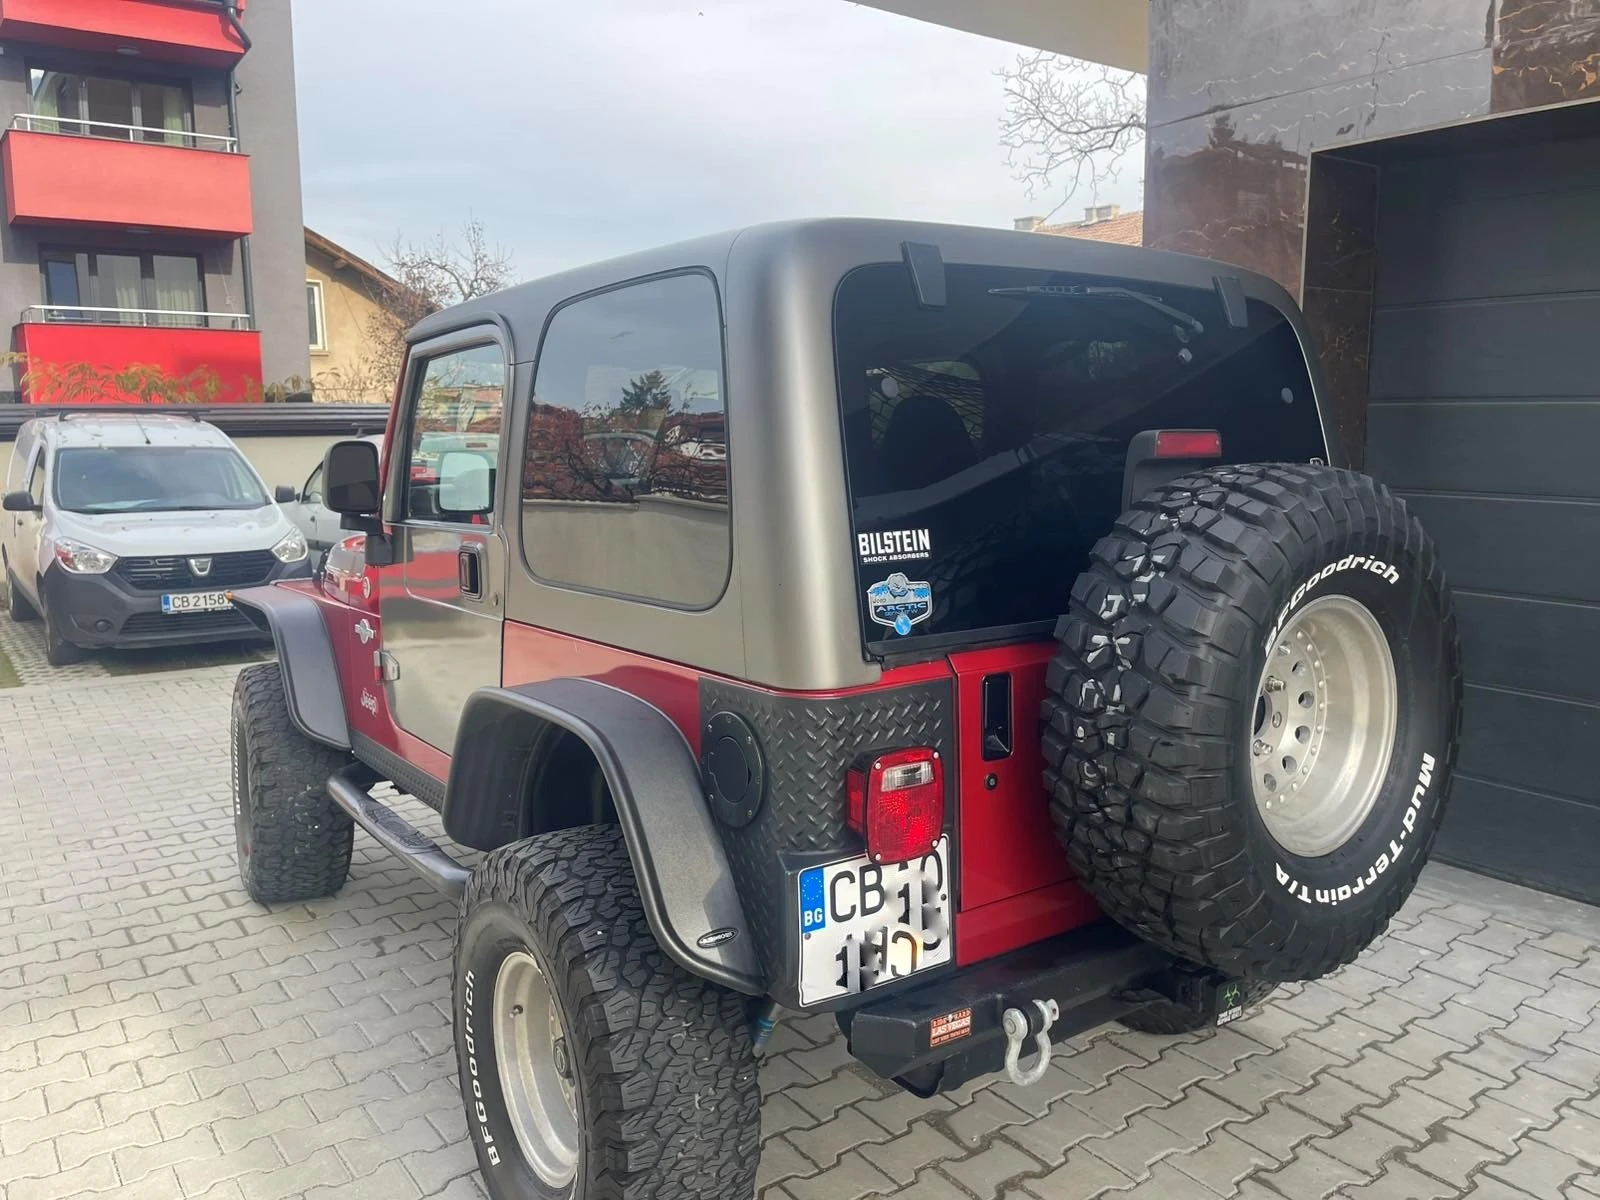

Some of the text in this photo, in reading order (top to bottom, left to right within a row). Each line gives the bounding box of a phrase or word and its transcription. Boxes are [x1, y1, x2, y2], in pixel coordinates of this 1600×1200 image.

[858, 529, 931, 556] BILSTEIN
[889, 551, 930, 560] ABSORBERS
[172, 595, 191, 609] CB
[192, 593, 225, 608] 2158
[876, 602, 927, 613] ARCTIC
[1264, 553, 1401, 658] BFGoodrich
[1315, 752, 1436, 906] Mud-Terrain
[803, 910, 824, 927] BG
[463, 969, 501, 1167] BFGoodrich
